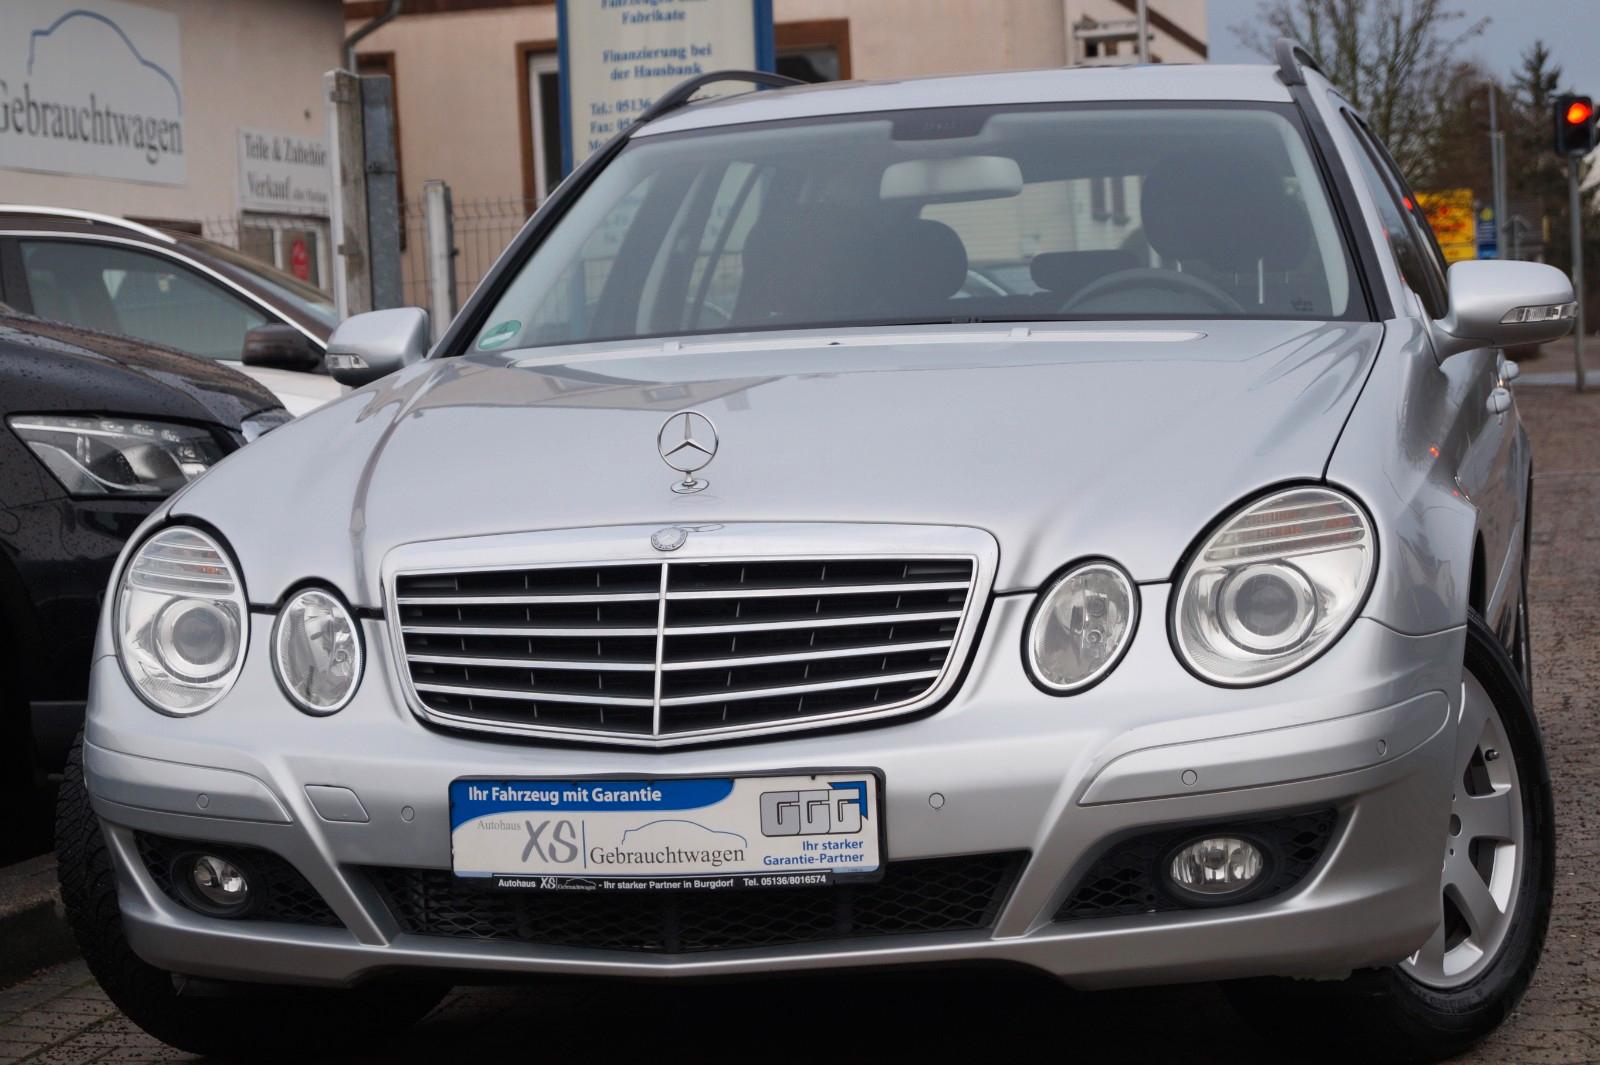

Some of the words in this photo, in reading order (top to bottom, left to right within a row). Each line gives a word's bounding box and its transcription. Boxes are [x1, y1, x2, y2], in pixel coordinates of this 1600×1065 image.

[622, 10, 686, 24] Fabrikate
[602, 47, 686, 62] Finanzierung
[690, 43, 712, 56] bei
[610, 67, 630, 80] der
[634, 63, 702, 78] Hausbank
[247, 171, 290, 200] Verkauf
[468, 786, 488, 801] Ihr
[491, 787, 559, 805] Fahrzeug
[562, 787, 589, 802] mit
[591, 787, 662, 803] Garantie
[477, 819, 522, 831] Autohaus
[521, 819, 578, 864] XS
[590, 846, 745, 866] Gebrauchtwagen
[802, 840, 819, 851] Ihr
[822, 839, 864, 851] starker
[763, 853, 864, 866] Garantie-Partner
[498, 879, 536, 888] Autohaus
[540, 877, 556, 890] XS
[603, 881, 615, 889] Ihr
[617, 881, 647, 889] starker
[649, 881, 682, 889] Partner
[683, 880, 692, 888] in
[694, 879, 734, 890] Burgdorf
[743, 878, 758, 886] Tel.
[761, 875, 827, 885] 05136/8016574
